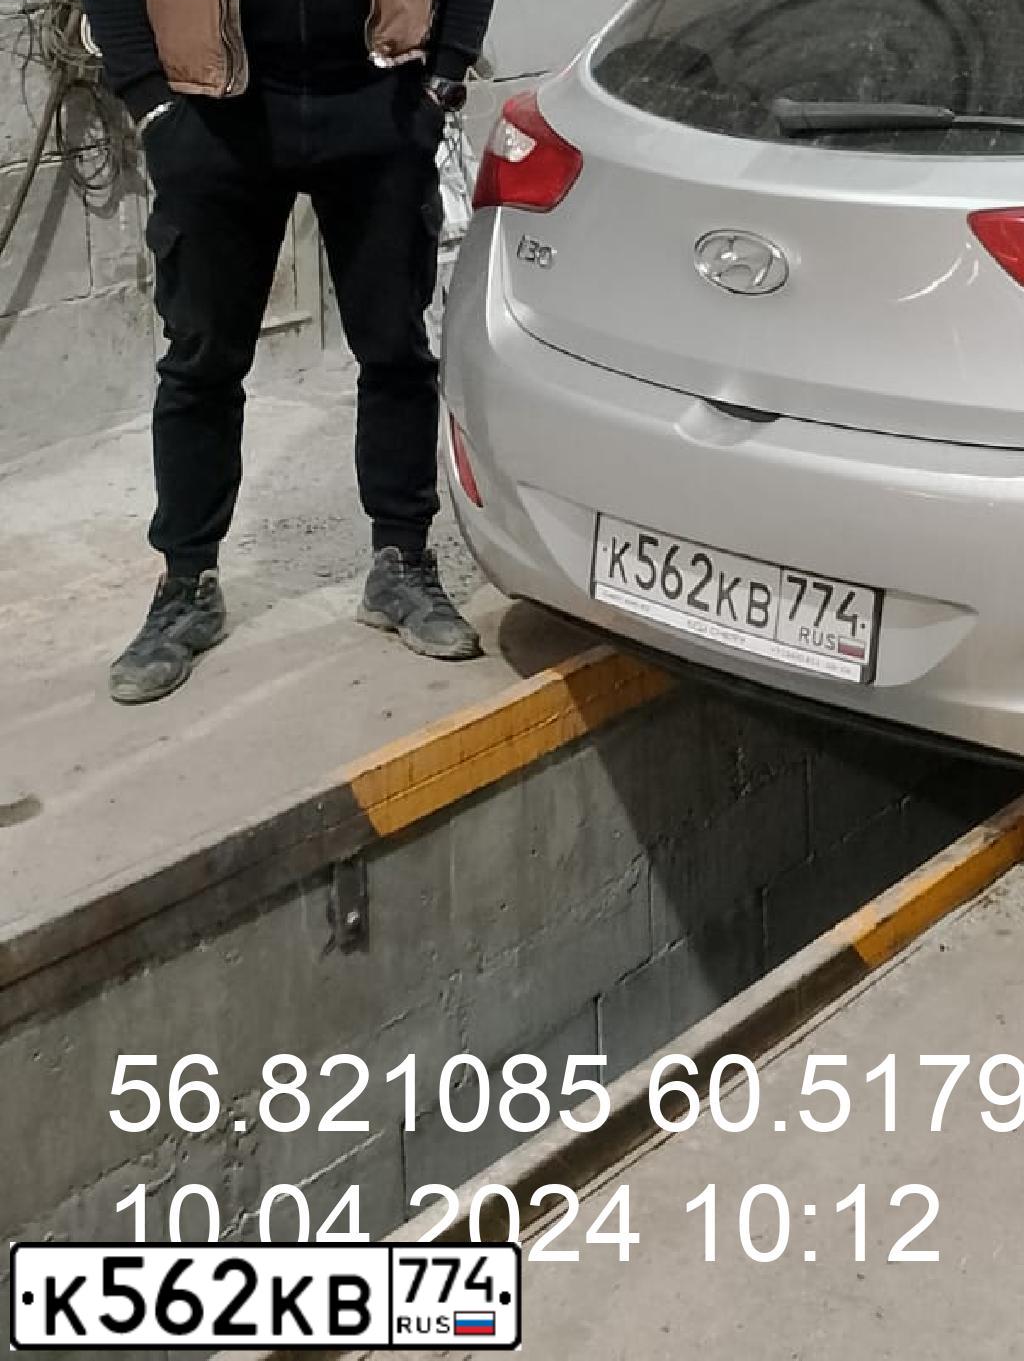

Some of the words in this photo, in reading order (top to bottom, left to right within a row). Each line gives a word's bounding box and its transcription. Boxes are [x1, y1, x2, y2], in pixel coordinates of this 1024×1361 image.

[609, 533, 770, 628] К562КВ
[787, 575, 859, 637] 774
[799, 625, 836, 651] RUS
